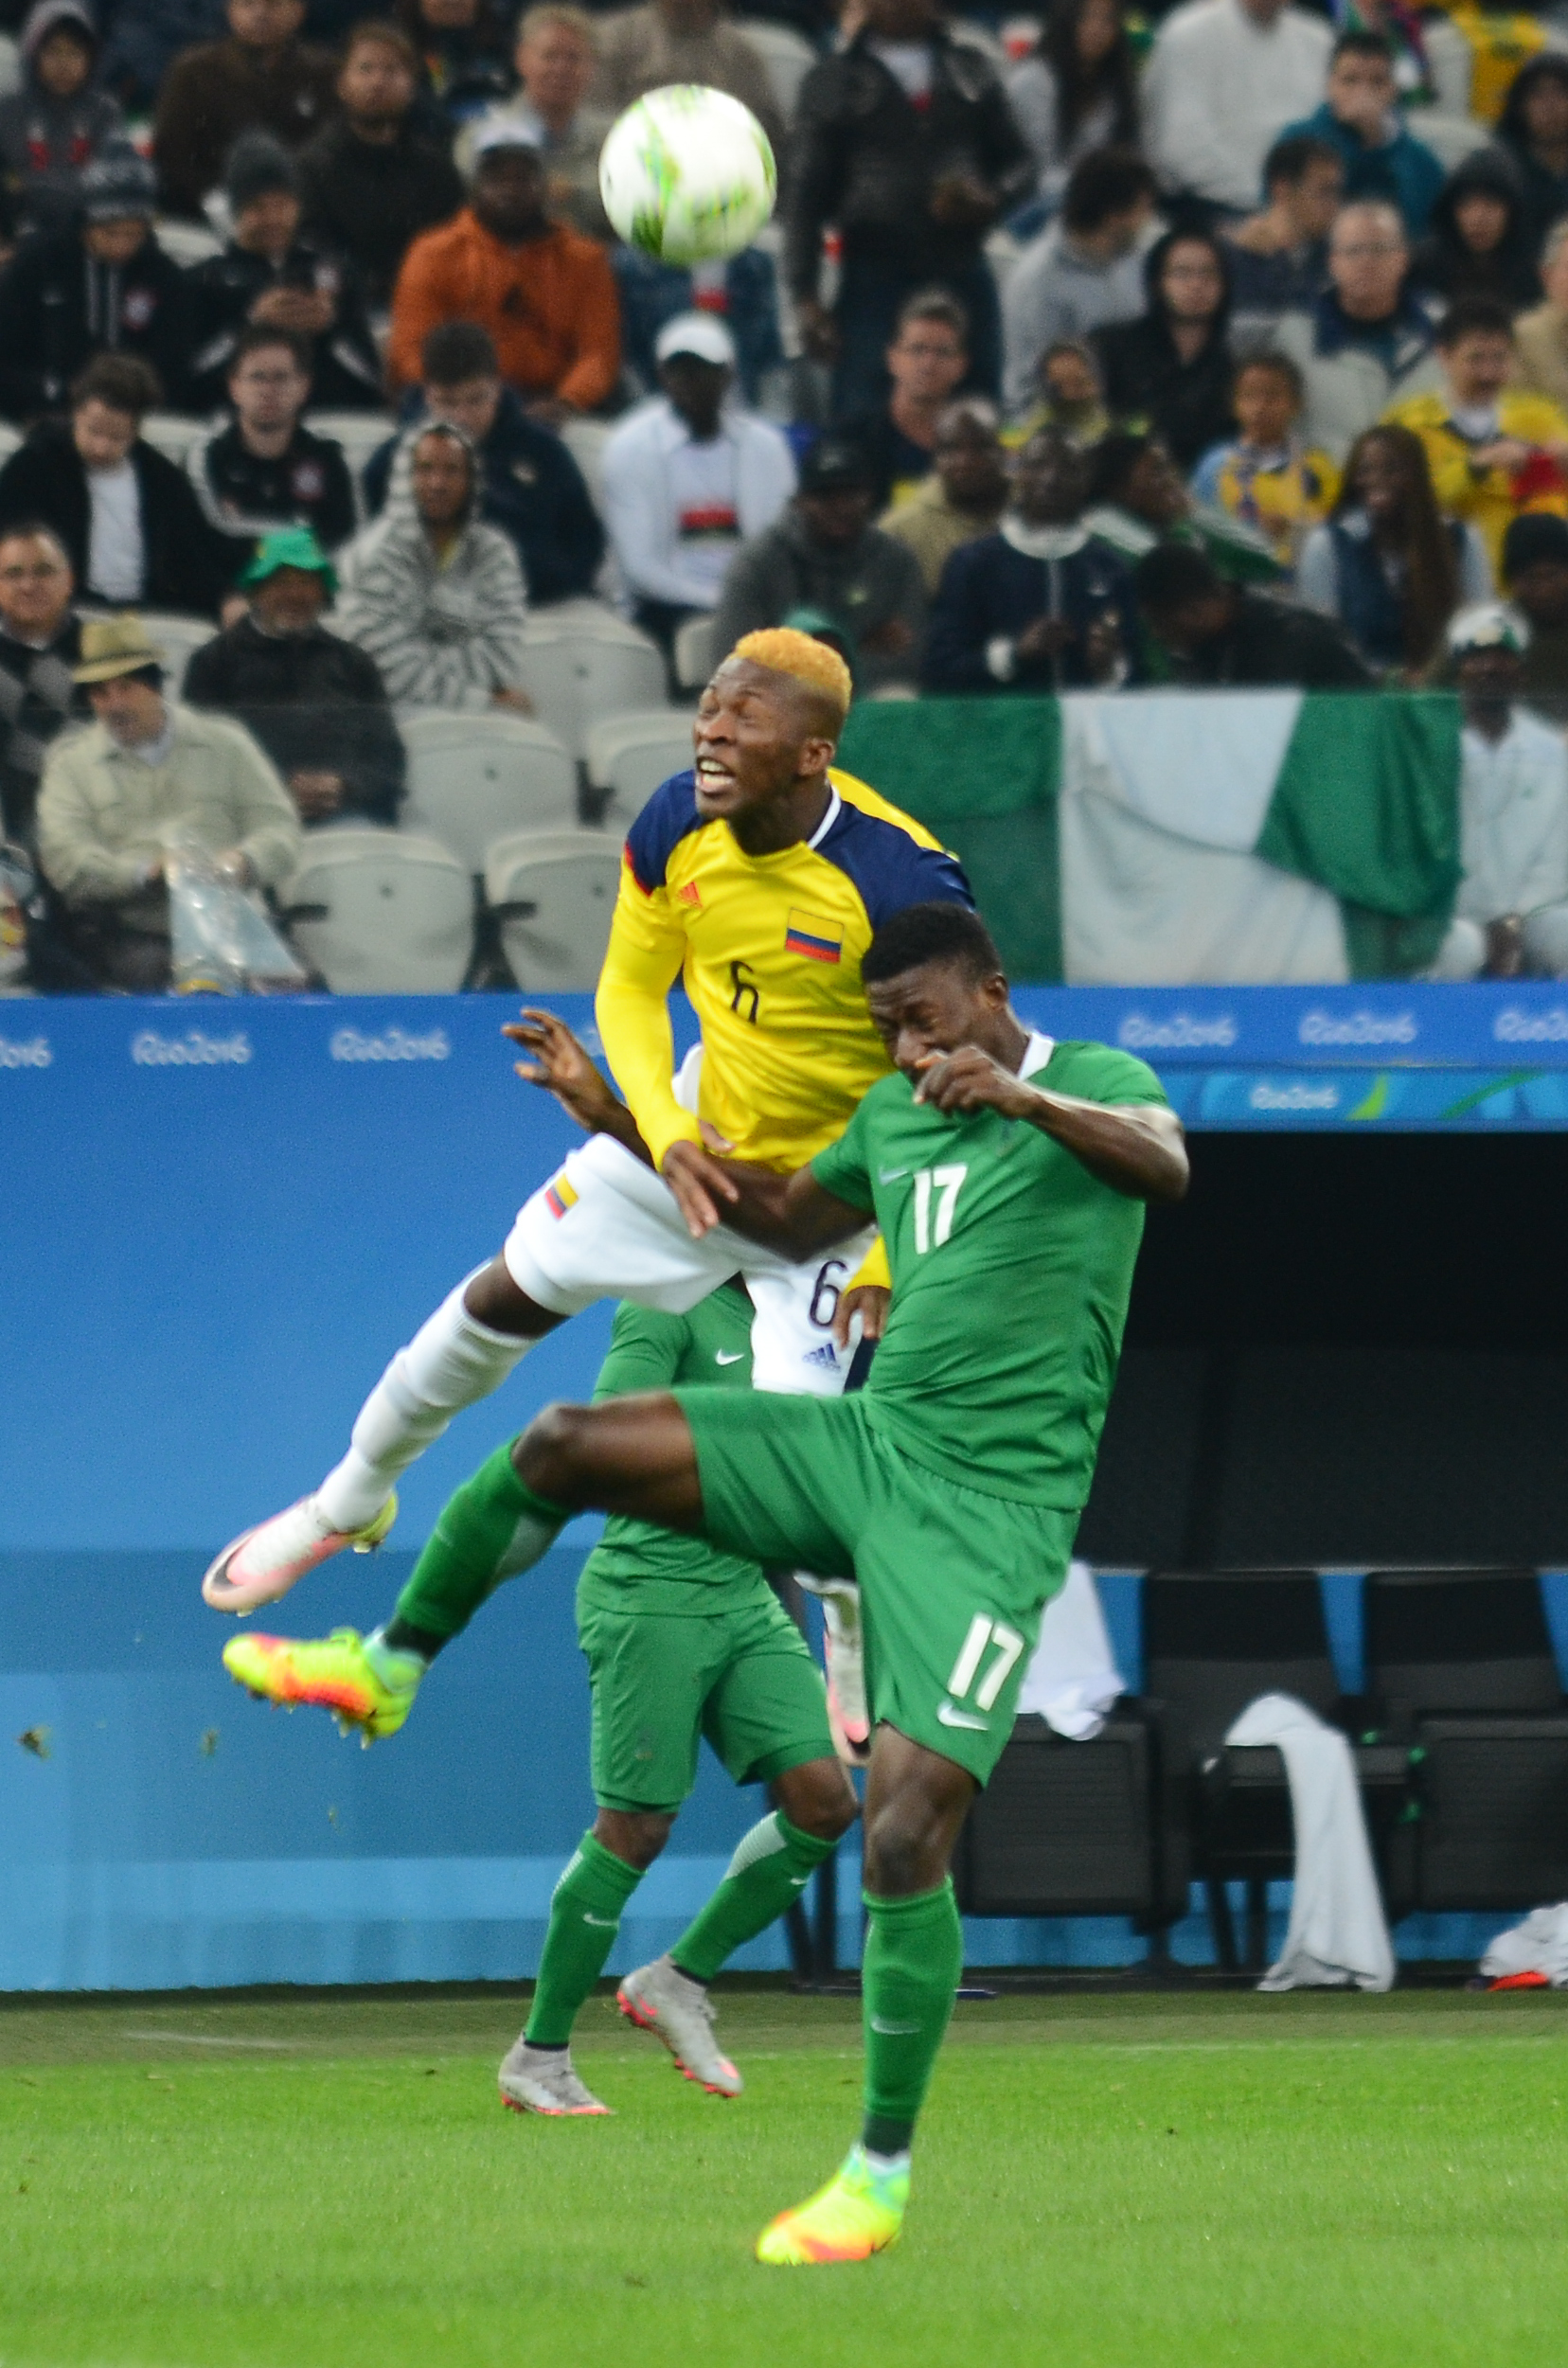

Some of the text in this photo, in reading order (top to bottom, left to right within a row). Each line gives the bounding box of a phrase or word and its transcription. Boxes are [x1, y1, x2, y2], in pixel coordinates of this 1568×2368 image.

[913, 1163, 969, 1255] 17
[810, 1260, 848, 1327] 6
[947, 1611, 1025, 1712] 17
